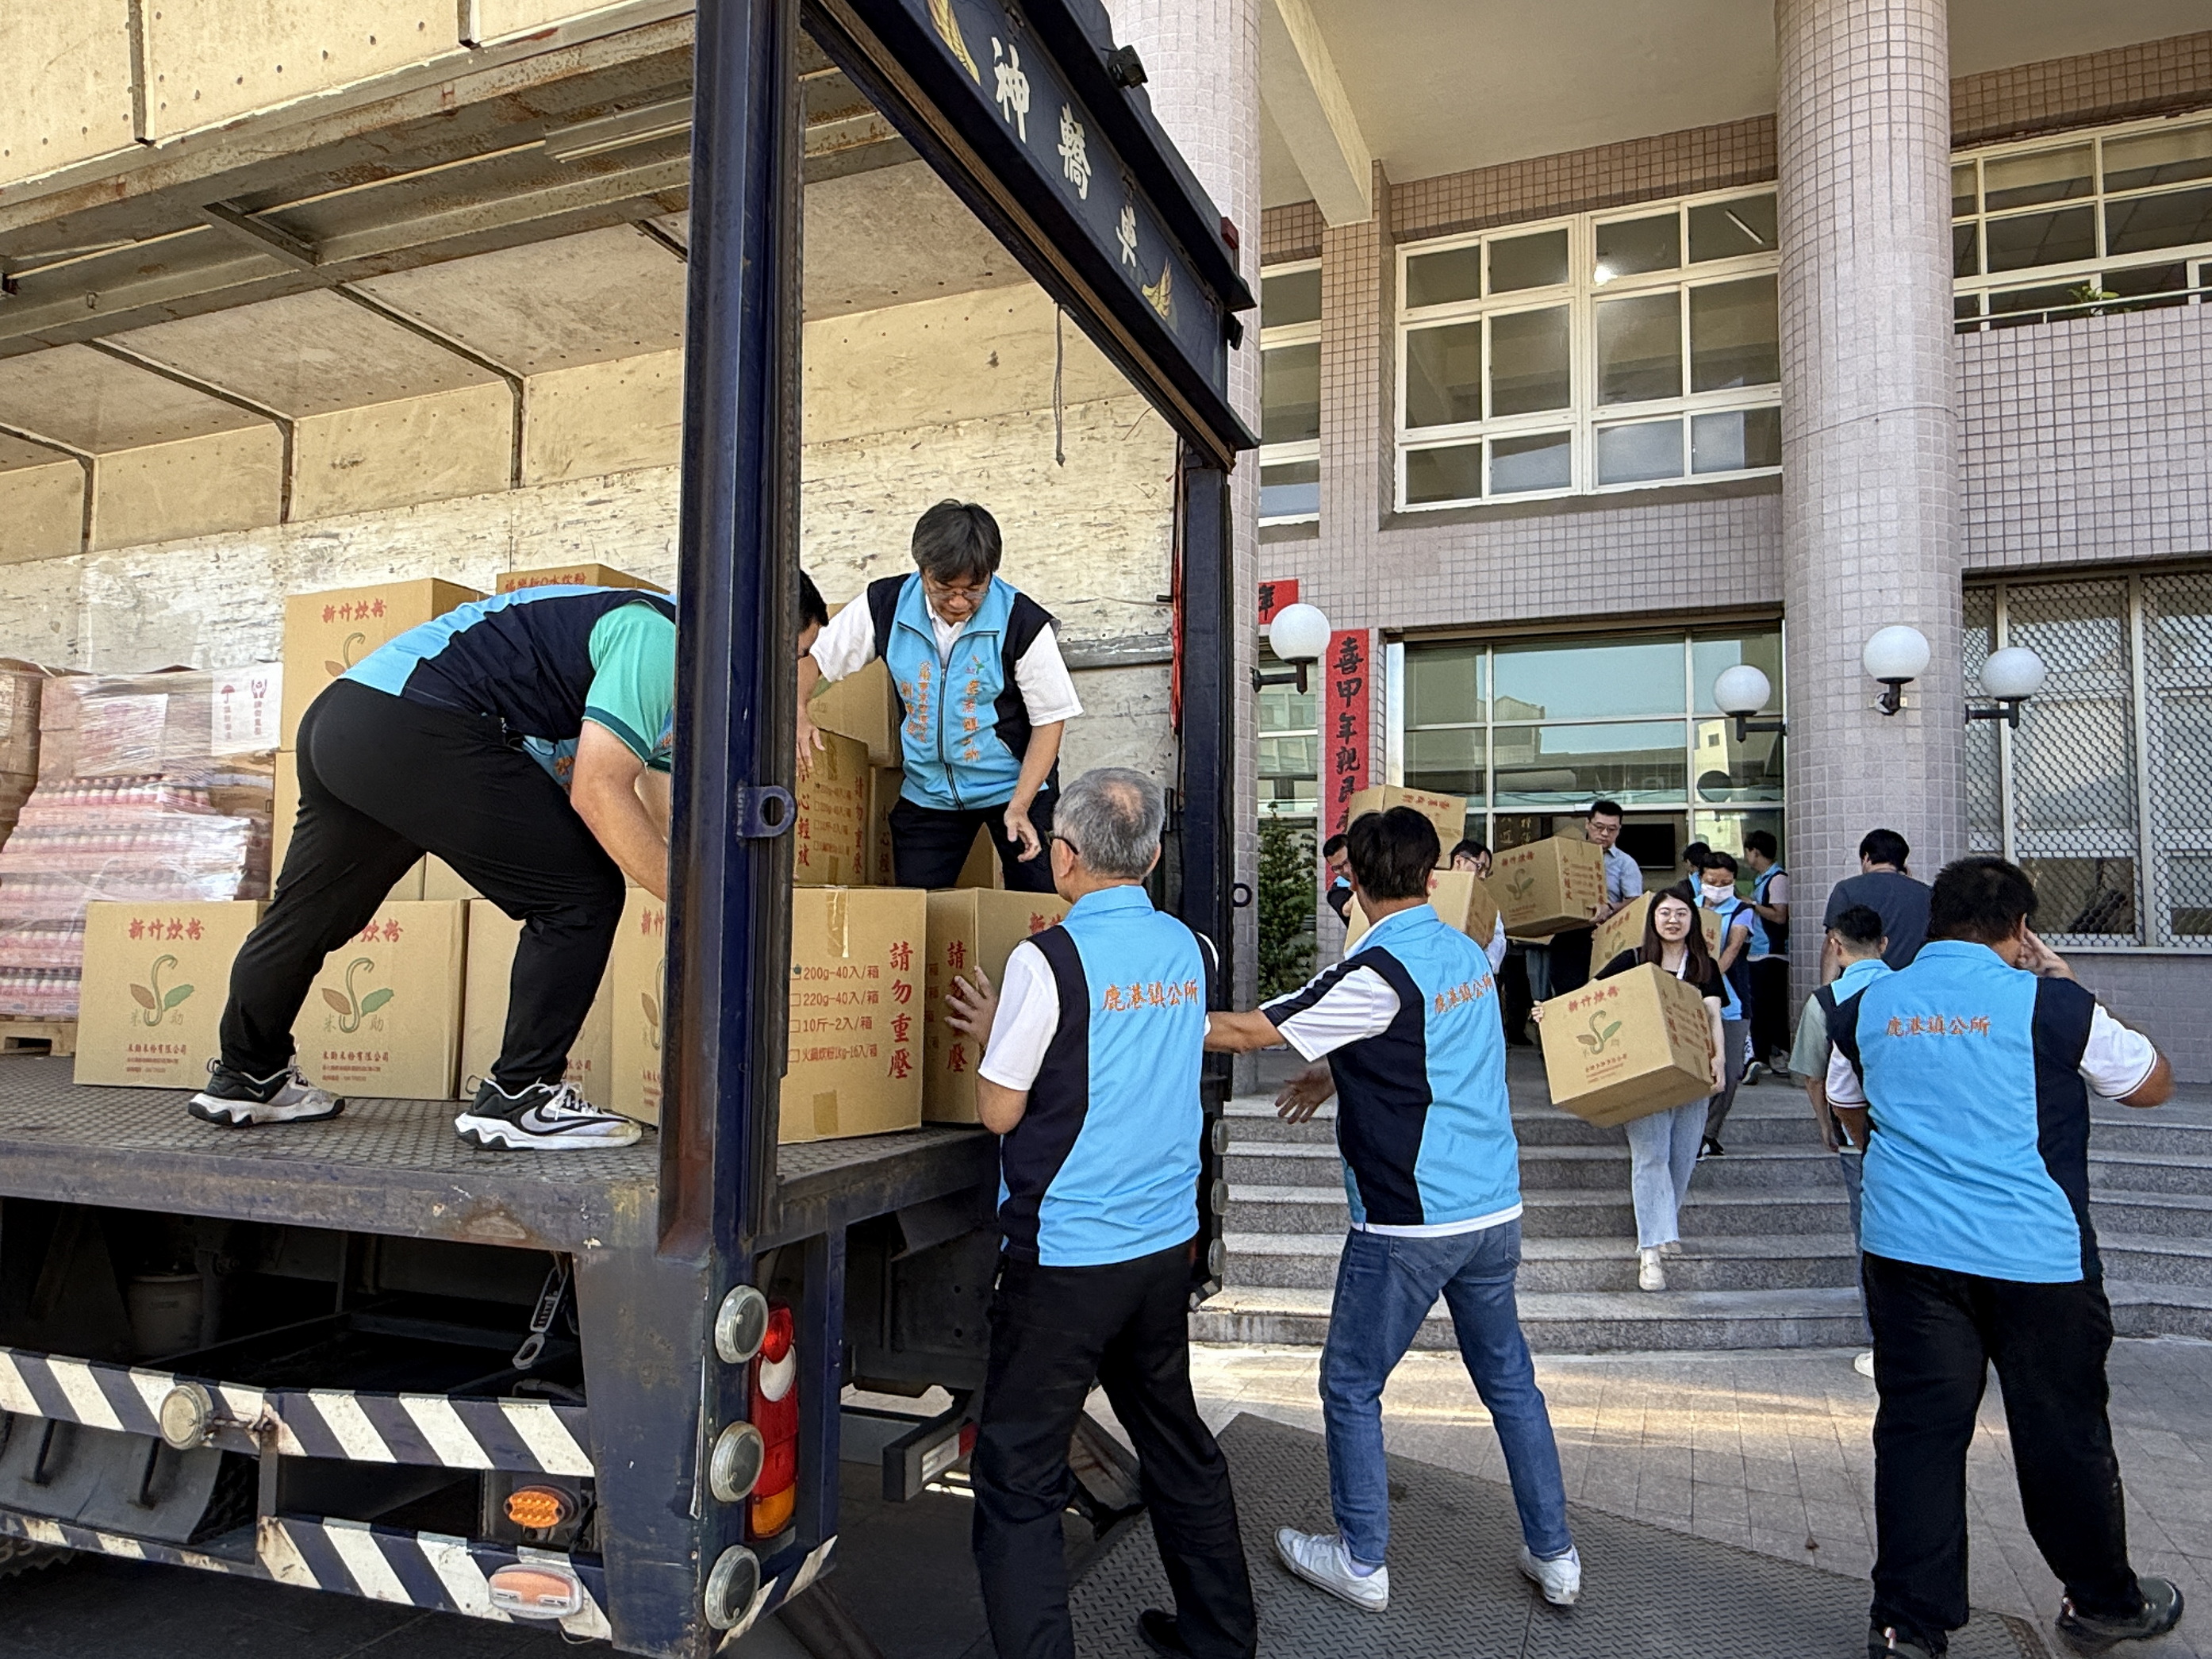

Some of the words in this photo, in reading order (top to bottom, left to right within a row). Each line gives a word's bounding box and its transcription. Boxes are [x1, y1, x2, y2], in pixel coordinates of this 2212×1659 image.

[321, 598, 387, 624] 新竹炊粉
[129, 917, 205, 941] 新竹炊粉
[351, 918, 404, 943] 炊粉
[803, 965, 879, 981] 200g-40入/箱
[803, 990, 878, 1006] 220g-40入/箱
[1102, 978, 1199, 1012] 鹿港鎮公所
[1434, 971, 1494, 1016] 鹿港鎮公所
[887, 941, 913, 1079] 請勿重壓
[803, 1016, 873, 1032] 10斤-2入/箱
[1886, 1014, 1991, 1037] 鹿港鎮公所
